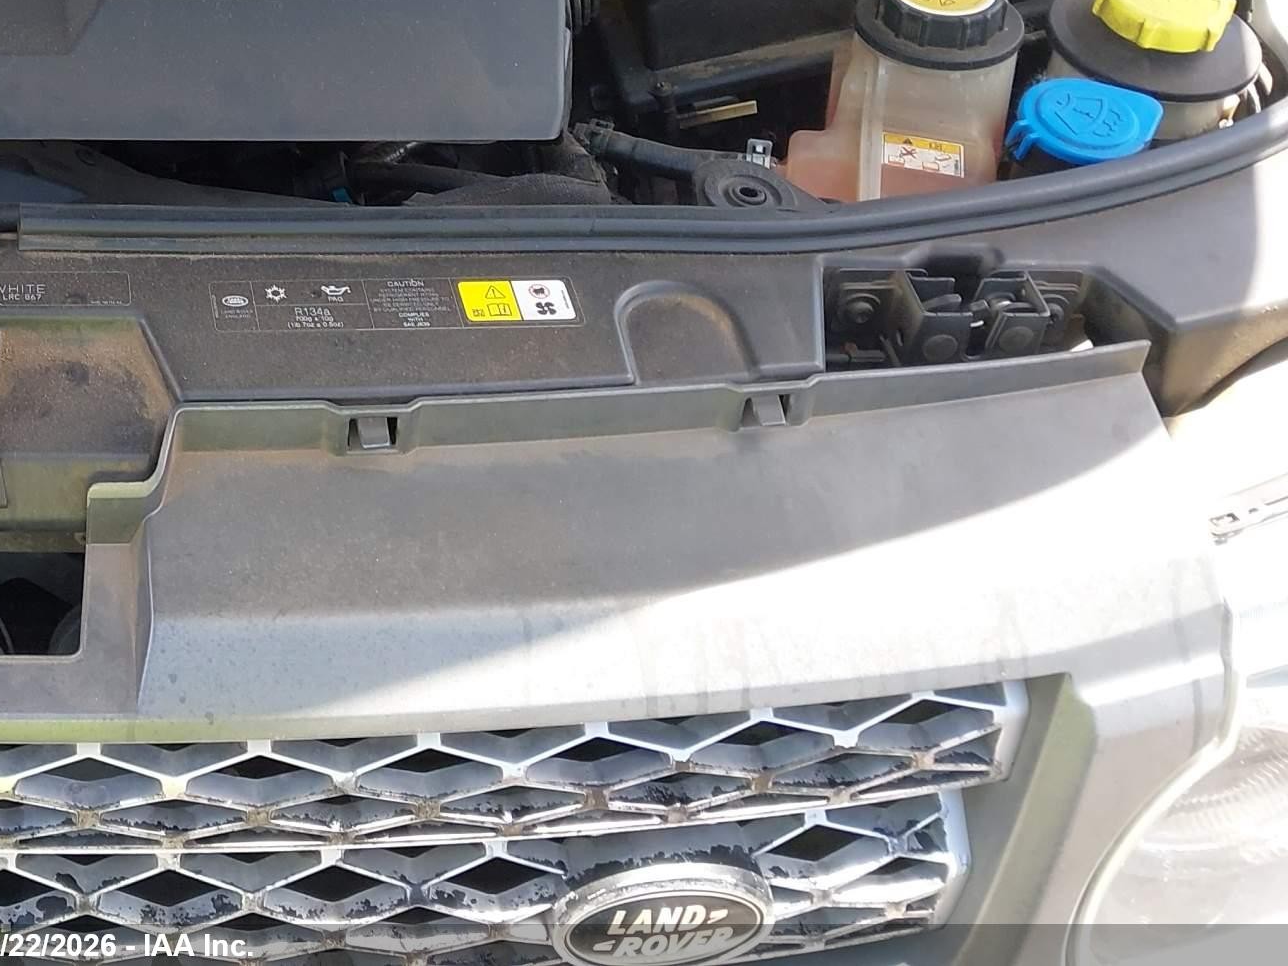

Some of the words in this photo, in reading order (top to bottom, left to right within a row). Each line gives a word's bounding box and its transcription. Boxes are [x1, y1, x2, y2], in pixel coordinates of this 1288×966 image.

[387, 279, 425, 287] CAUTION
[294, 307, 331, 316] R134a
[607, 904, 707, 935] LAND
[612, 926, 735, 958] ROVER
